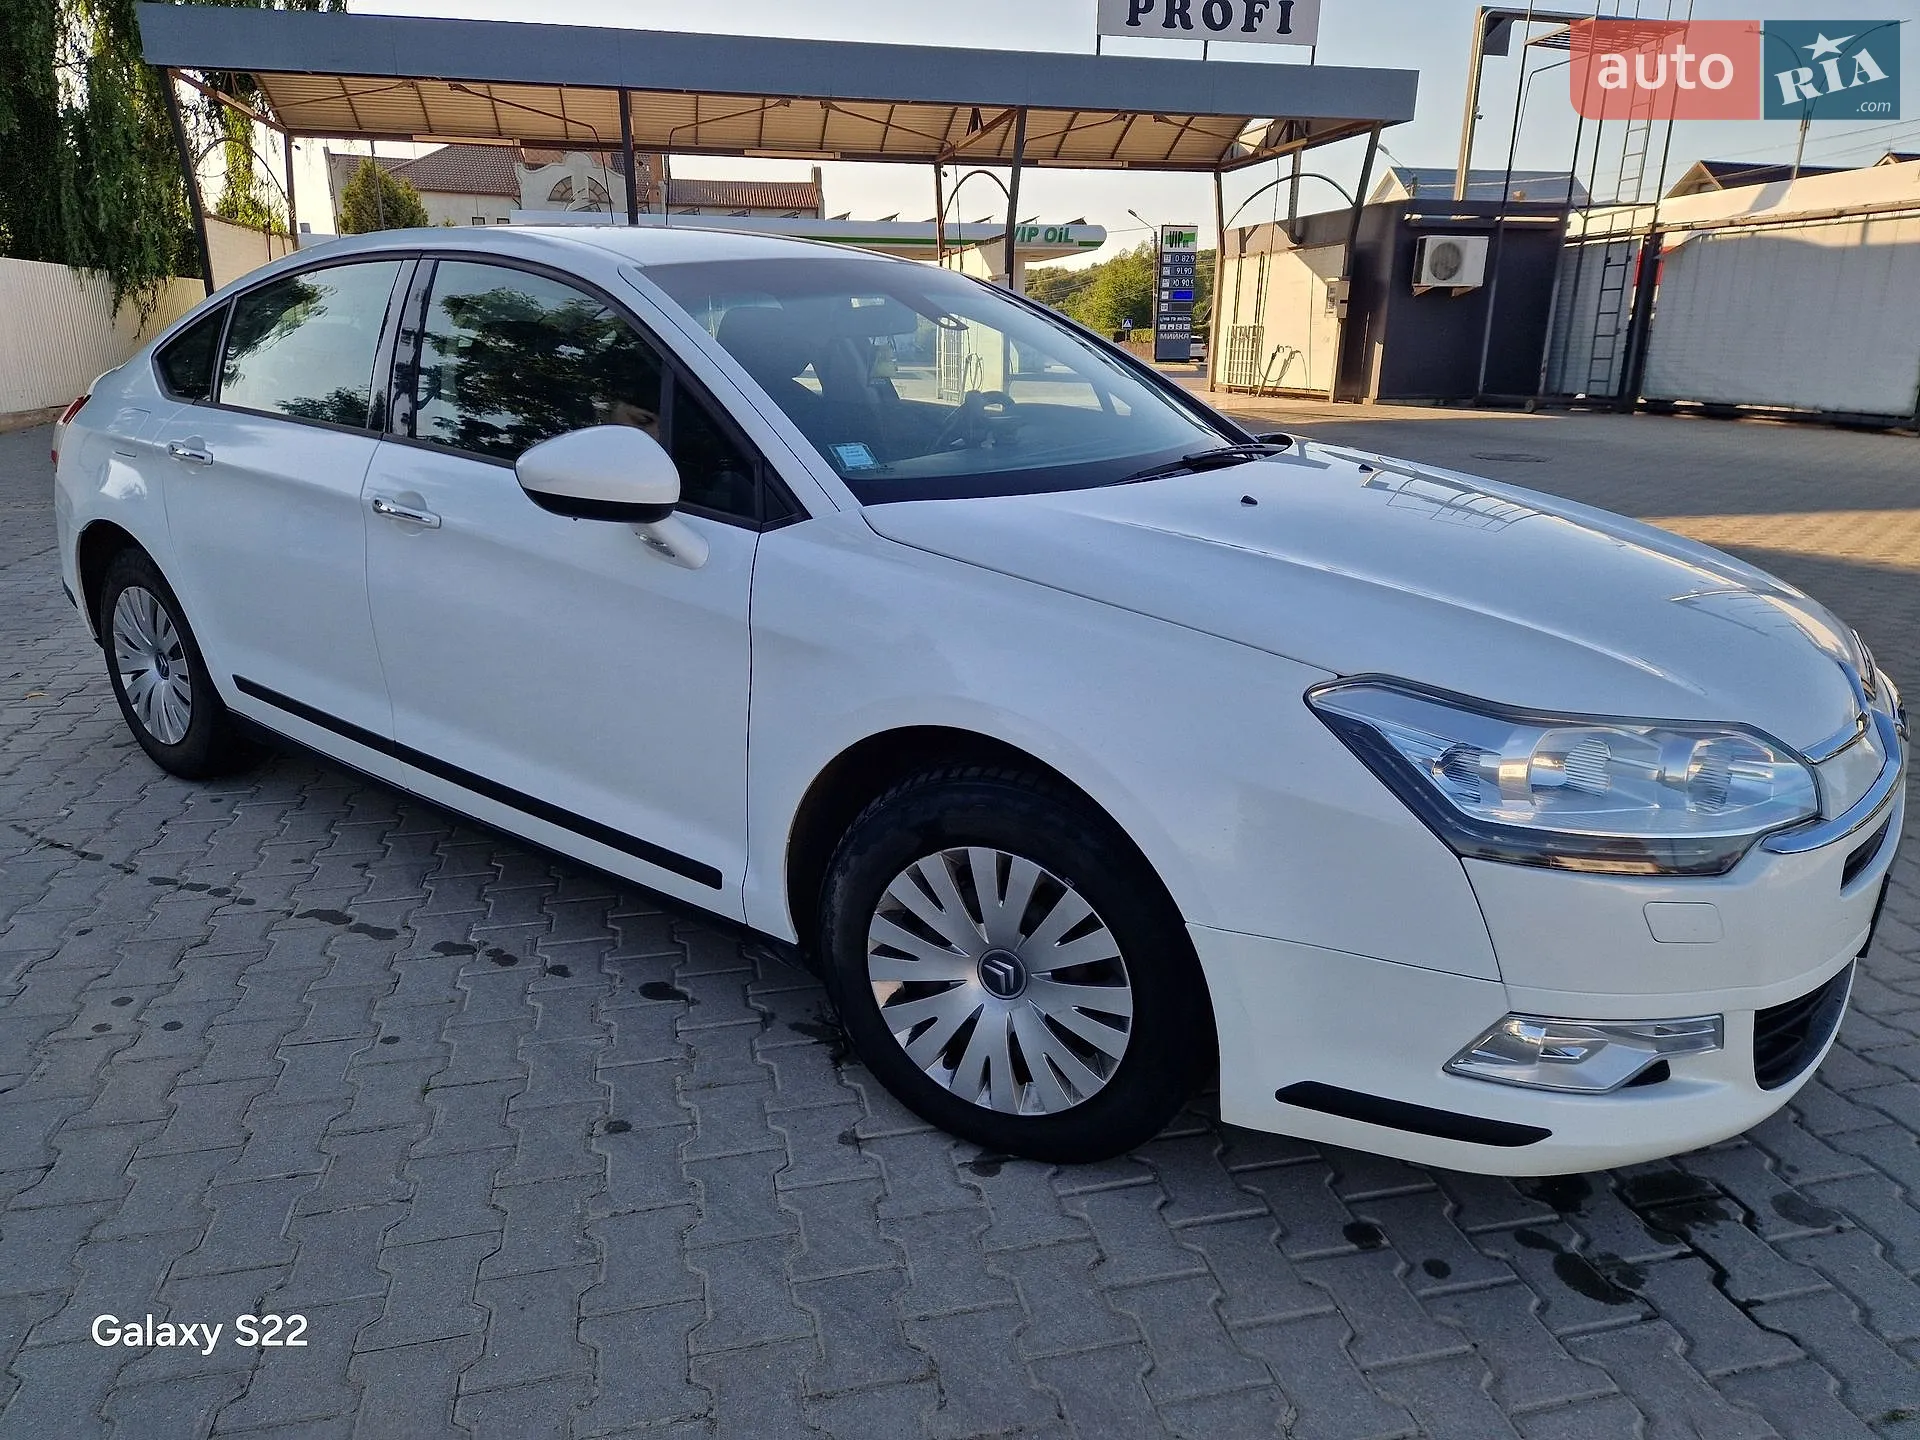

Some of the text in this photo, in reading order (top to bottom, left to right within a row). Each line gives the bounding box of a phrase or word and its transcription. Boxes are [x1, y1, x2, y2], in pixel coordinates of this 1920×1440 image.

[1125, 0, 1295, 34] PROFI
[1169, 230, 1184, 249] VIP
[1160, 331, 1190, 340] МИЙКА
